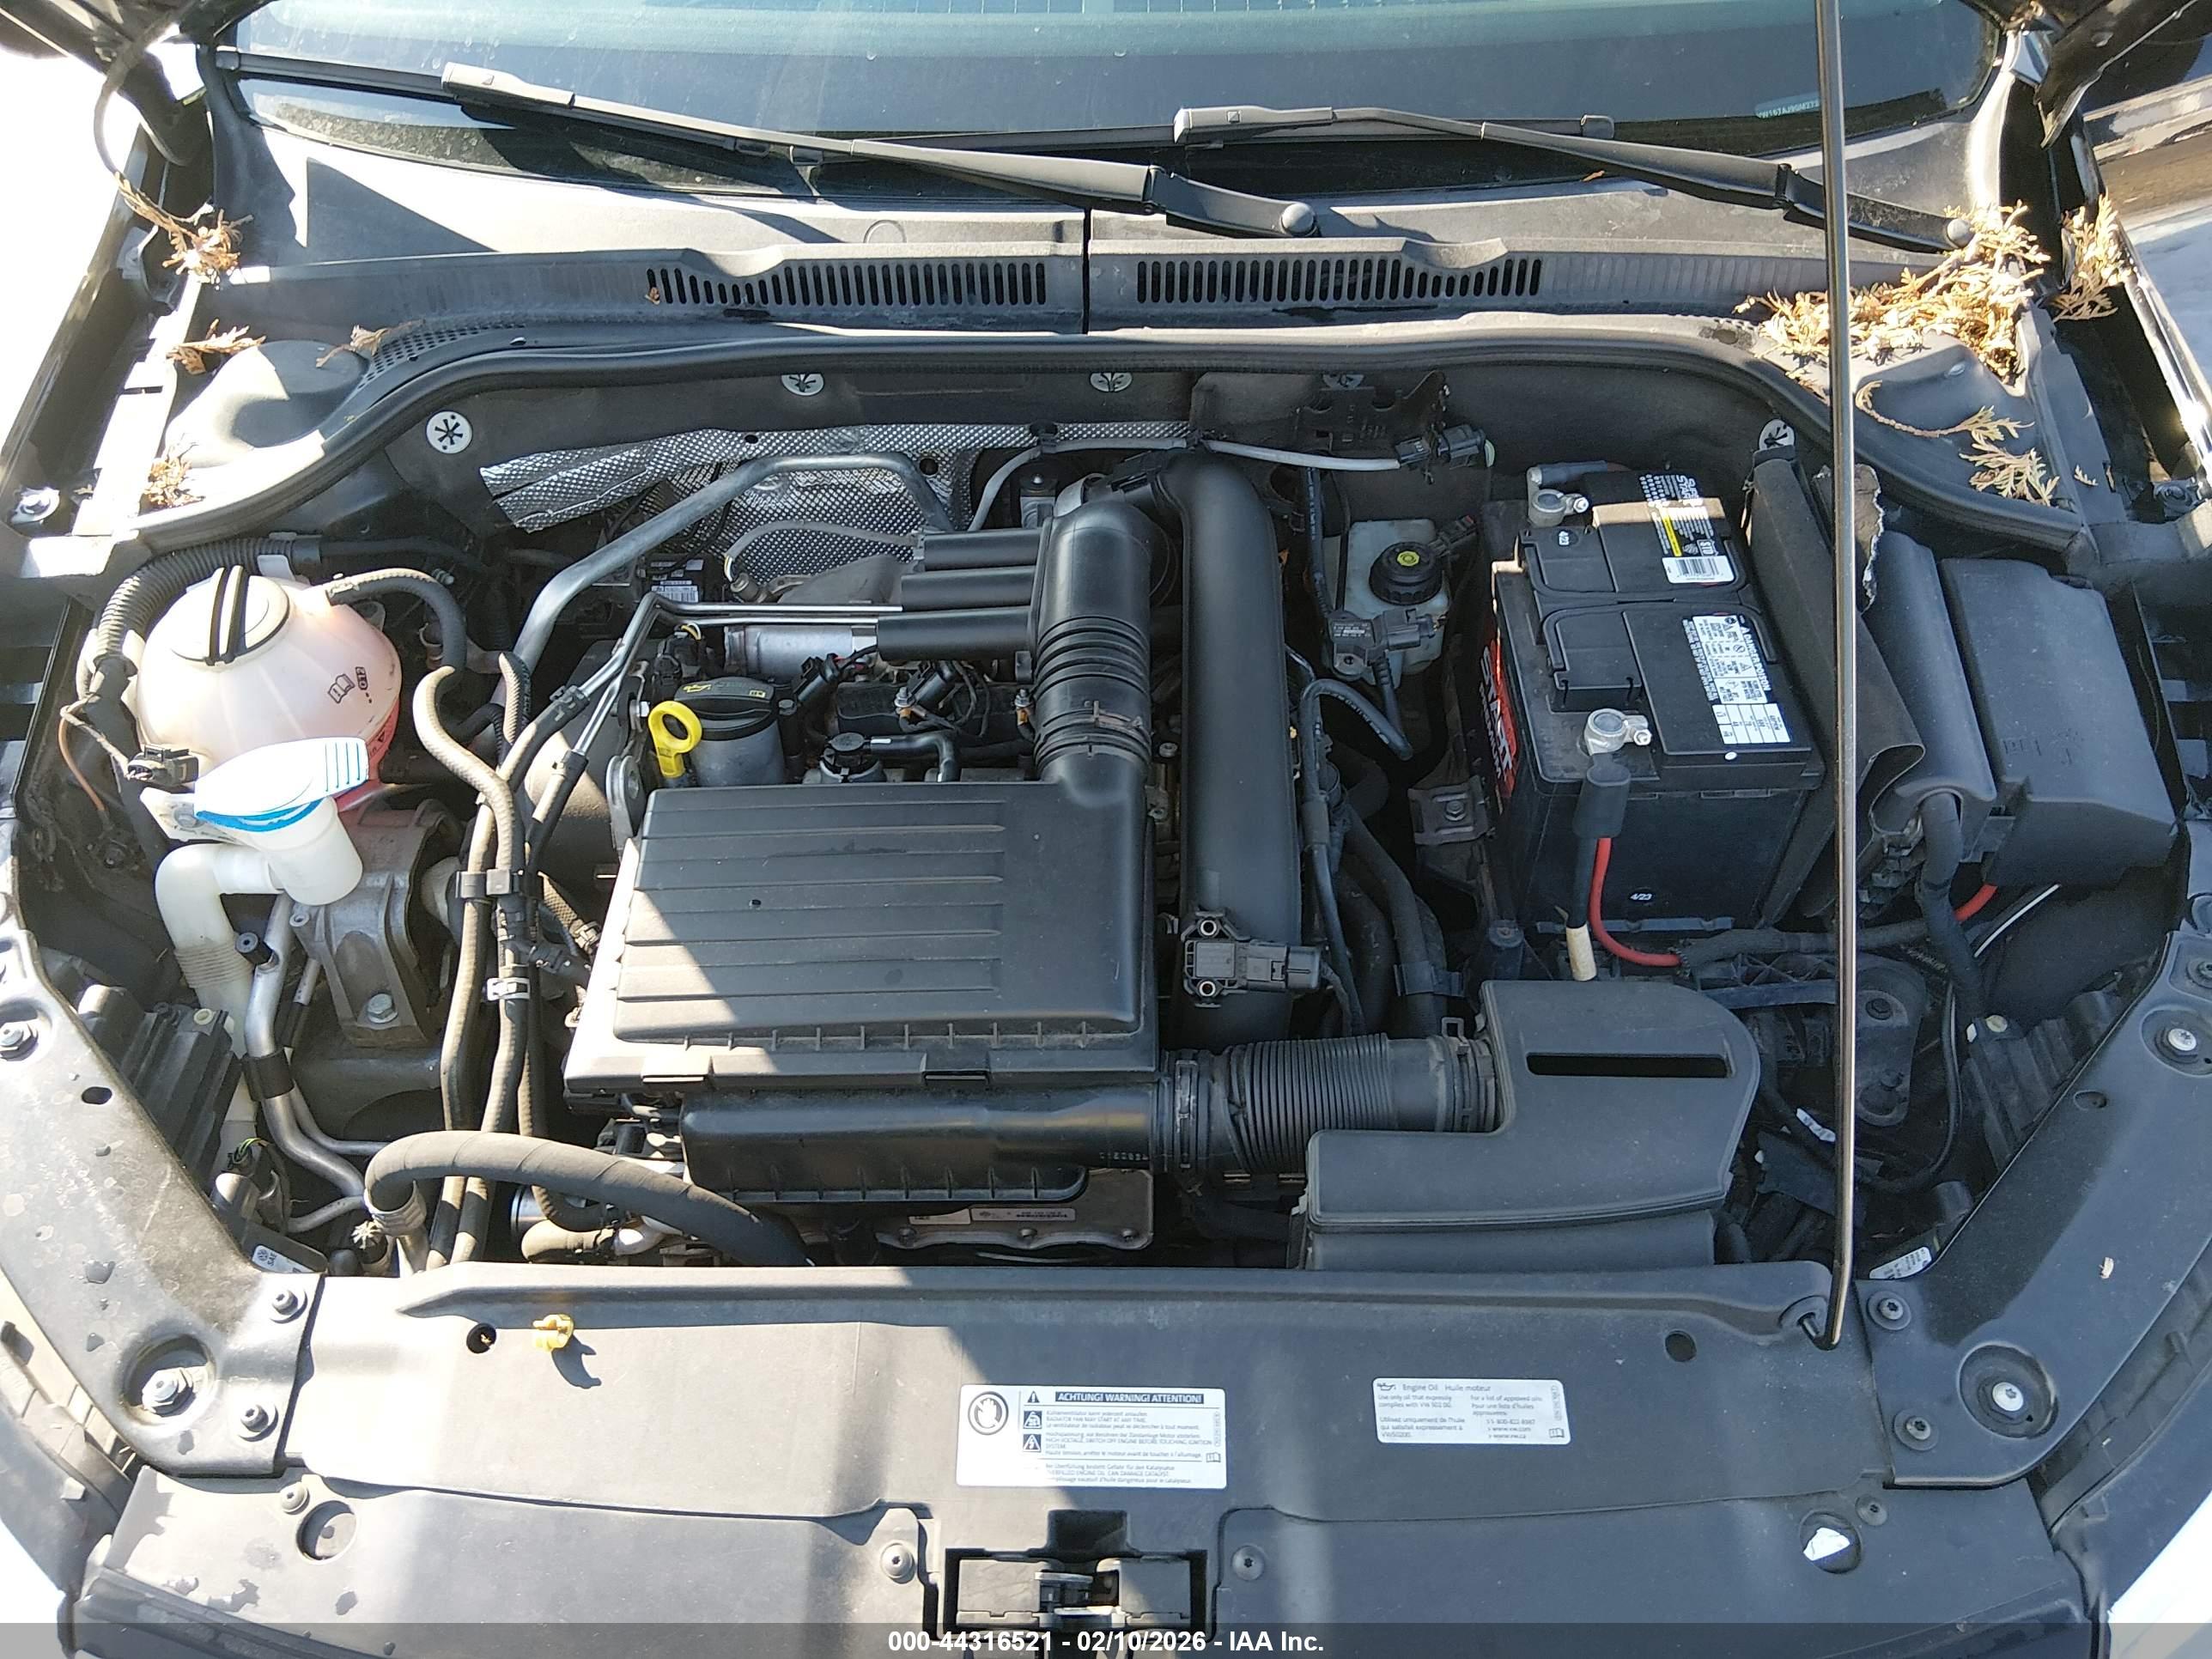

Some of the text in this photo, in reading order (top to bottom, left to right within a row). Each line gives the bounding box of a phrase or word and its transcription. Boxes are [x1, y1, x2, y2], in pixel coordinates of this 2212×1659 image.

[1743, 634, 1772, 691] DANGER POISON
[1105, 1393, 1149, 1401] WARNING!
[1151, 1394, 1201, 1402] ATTENTION!
